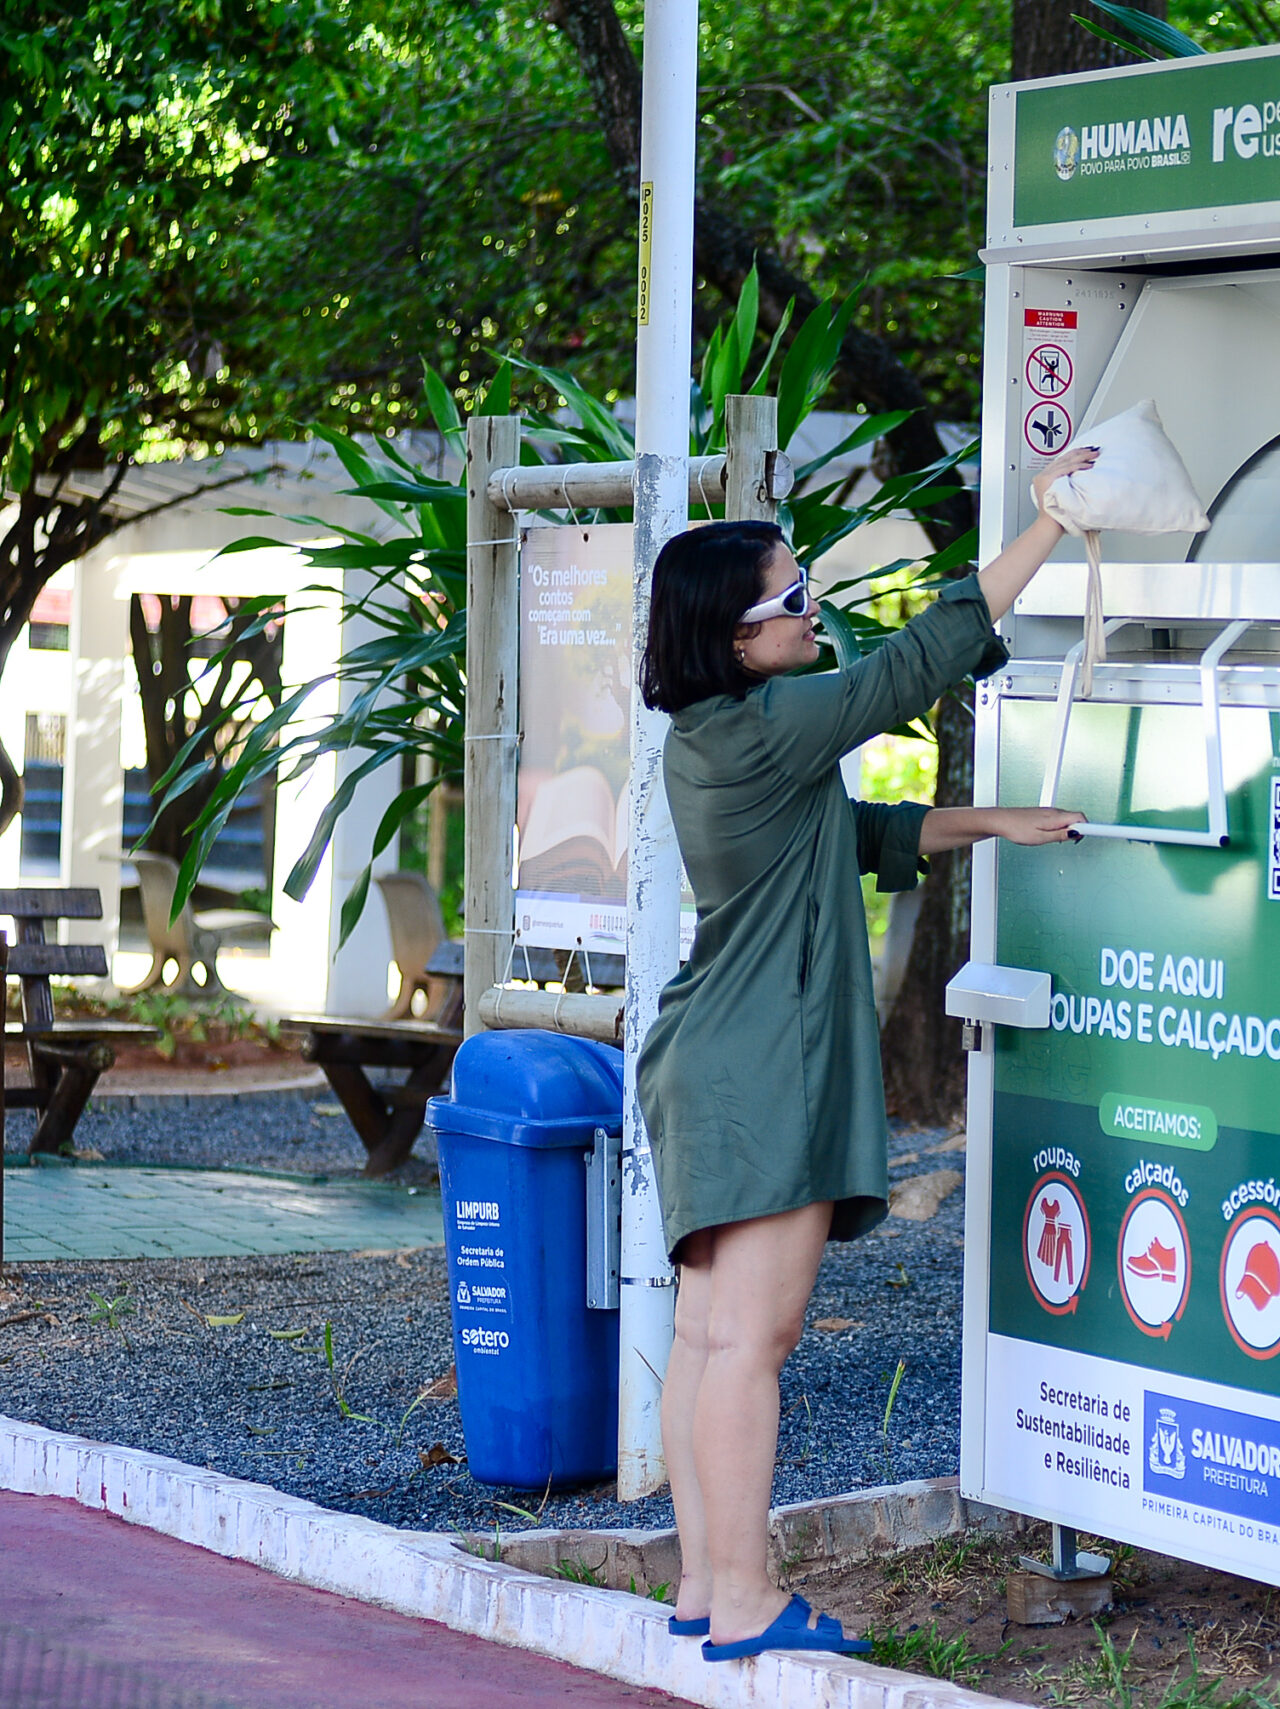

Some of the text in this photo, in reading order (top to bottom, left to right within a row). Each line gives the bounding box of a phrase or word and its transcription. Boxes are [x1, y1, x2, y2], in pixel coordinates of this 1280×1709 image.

[1081, 114, 1190, 160] HUMANA
[1212, 103, 1262, 162] re
[1080, 161, 1103, 176] POVO
[1104, 159, 1126, 173] PARA
[1127, 157, 1150, 171] POVO
[1151, 152, 1182, 167] BRASIL
[642, 188, 651, 243] P025
[551, 565, 607, 586] melhores
[539, 590, 574, 606] contos
[529, 609, 591, 626] começam com
[560, 628, 584, 645] uma
[1101, 948, 1224, 999] DOE AQUI
[1050, 994, 1132, 1041] OUPAS
[1138, 1004, 1153, 1043] E
[1113, 1105, 1201, 1140] ACEITAMOS:
[1033, 1147, 1081, 1178] roupas
[1125, 1160, 1189, 1207] calçados
[456, 1200, 499, 1220] LIMPURB
[457, 1257, 504, 1268] Ordem Pública
[461, 1245, 504, 1257] Secretaria de
[472, 1286, 506, 1298] SALVADOR
[462, 1326, 509, 1348] sotero
[1040, 1381, 1131, 1422] Secretaria de
[1016, 1408, 1131, 1456] Sustentabilidade
[1044, 1451, 1130, 1489] e Resiliência
[1203, 1466, 1268, 1497] PREFEITURA
[1142, 1498, 1189, 1521] PRIMEIRA
[1193, 1512, 1235, 1534] CAPITAL
[1239, 1524, 1254, 1538] DO
